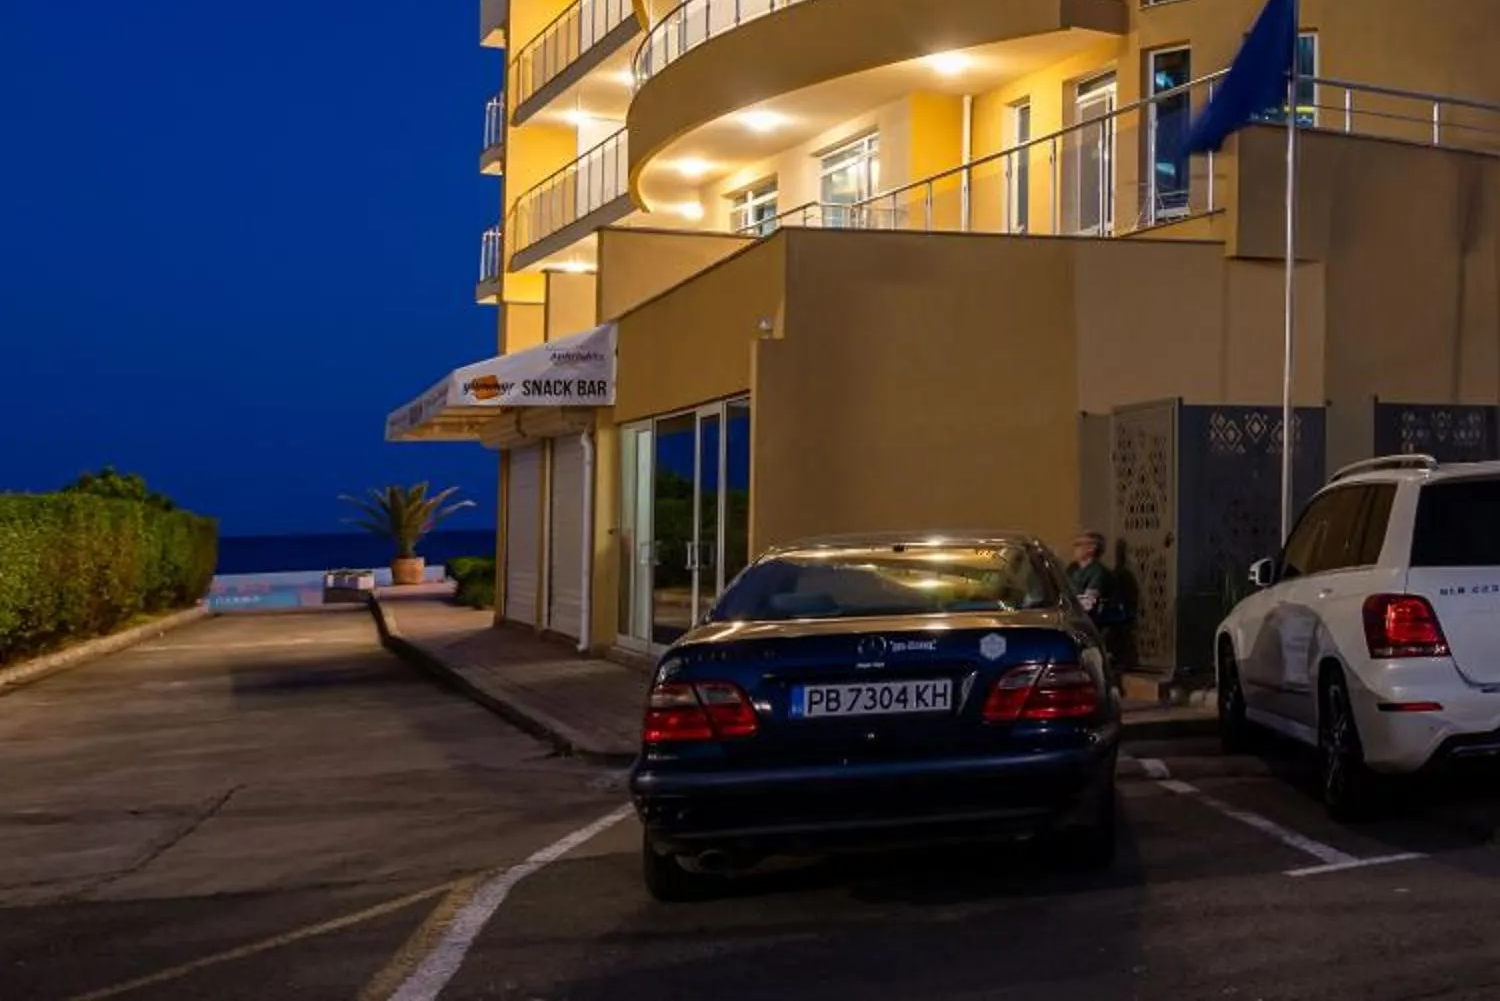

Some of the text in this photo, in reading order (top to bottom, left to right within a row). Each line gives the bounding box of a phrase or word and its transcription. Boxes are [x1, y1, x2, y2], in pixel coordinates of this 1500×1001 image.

[521, 379, 572, 397] SNACK
[577, 379, 607, 397] BAR
[807, 682, 949, 715] PB 7304 KH
